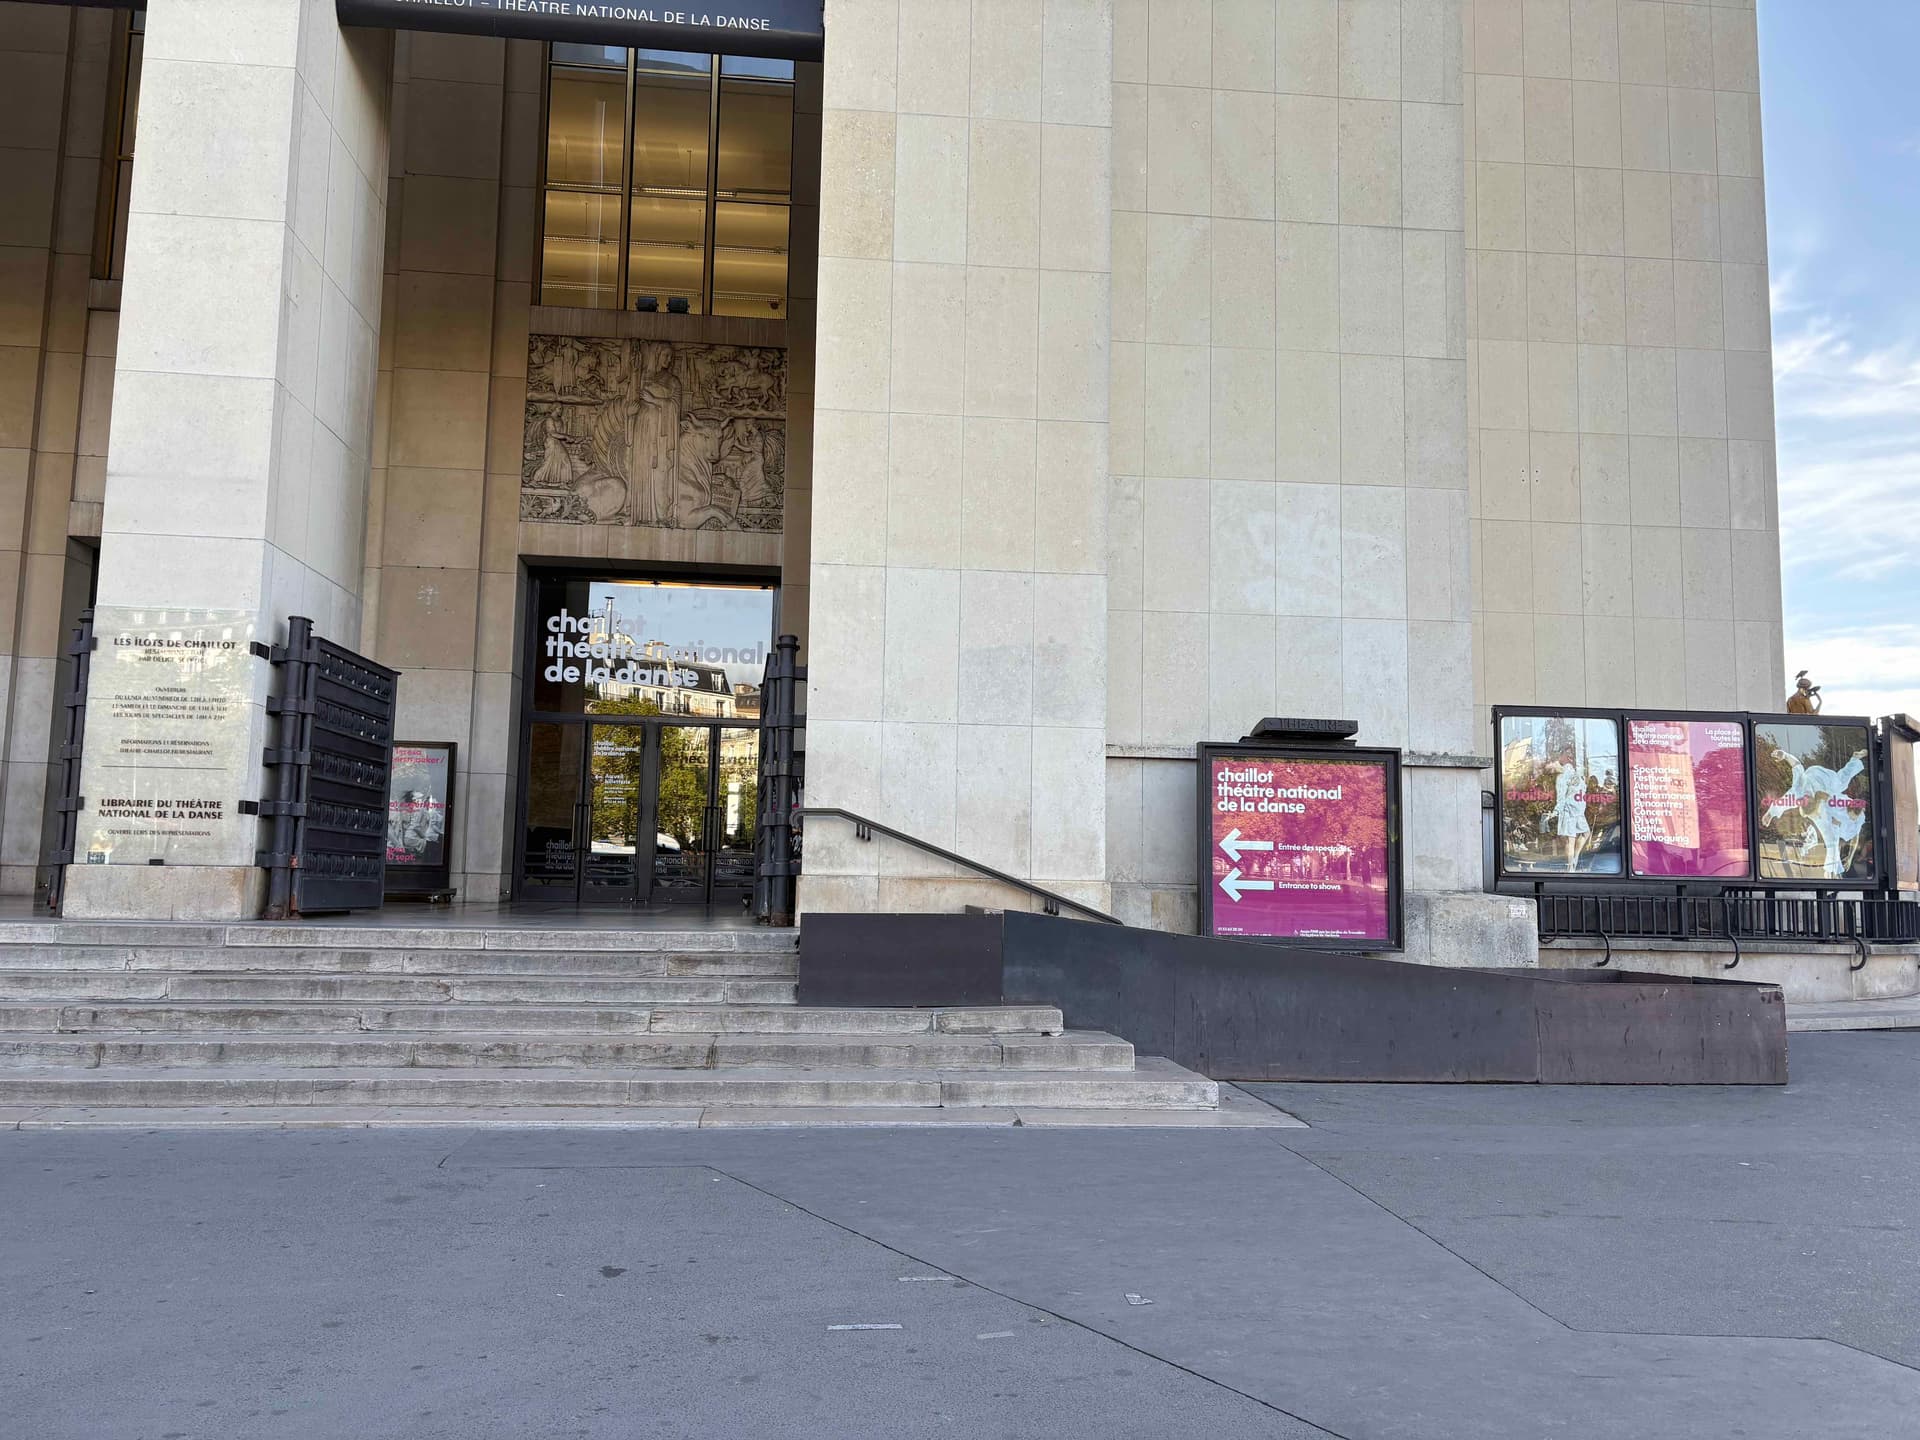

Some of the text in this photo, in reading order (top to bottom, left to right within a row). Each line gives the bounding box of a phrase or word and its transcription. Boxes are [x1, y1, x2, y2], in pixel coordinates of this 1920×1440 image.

[575, 5, 659, 22] NATIONAL
[664, 11, 685, 24] DE
[691, 14, 711, 27] LA
[716, 15, 770, 31] DANSE
[113, 638, 132, 646] LES
[167, 639, 181, 648] DE
[184, 640, 236, 649] CHAILLOT
[650, 641, 764, 665] national
[544, 658, 699, 687] de la danse
[1714, 729, 1732, 737] place
[1634, 765, 1680, 775] Spectacles
[1217, 768, 1274, 783] chaillot
[1217, 782, 1342, 800] théâtre national
[1634, 782, 1668, 790] Ateliers
[1634, 790, 1696, 800] Performances
[101, 798, 222, 809] LIBRAIRIE DU THÉÂTRE
[1217, 798, 1306, 813] de la danse
[1634, 799, 1683, 808] Rencontres
[99, 810, 223, 820] NATIONAL DE LA DANSE
[1634, 807, 1672, 816] Concerts
[1635, 824, 1665, 833] Battles
[1279, 843, 1300, 851] Entrée
[1310, 882, 1318, 890] to
[1319, 882, 1341, 890] shows
